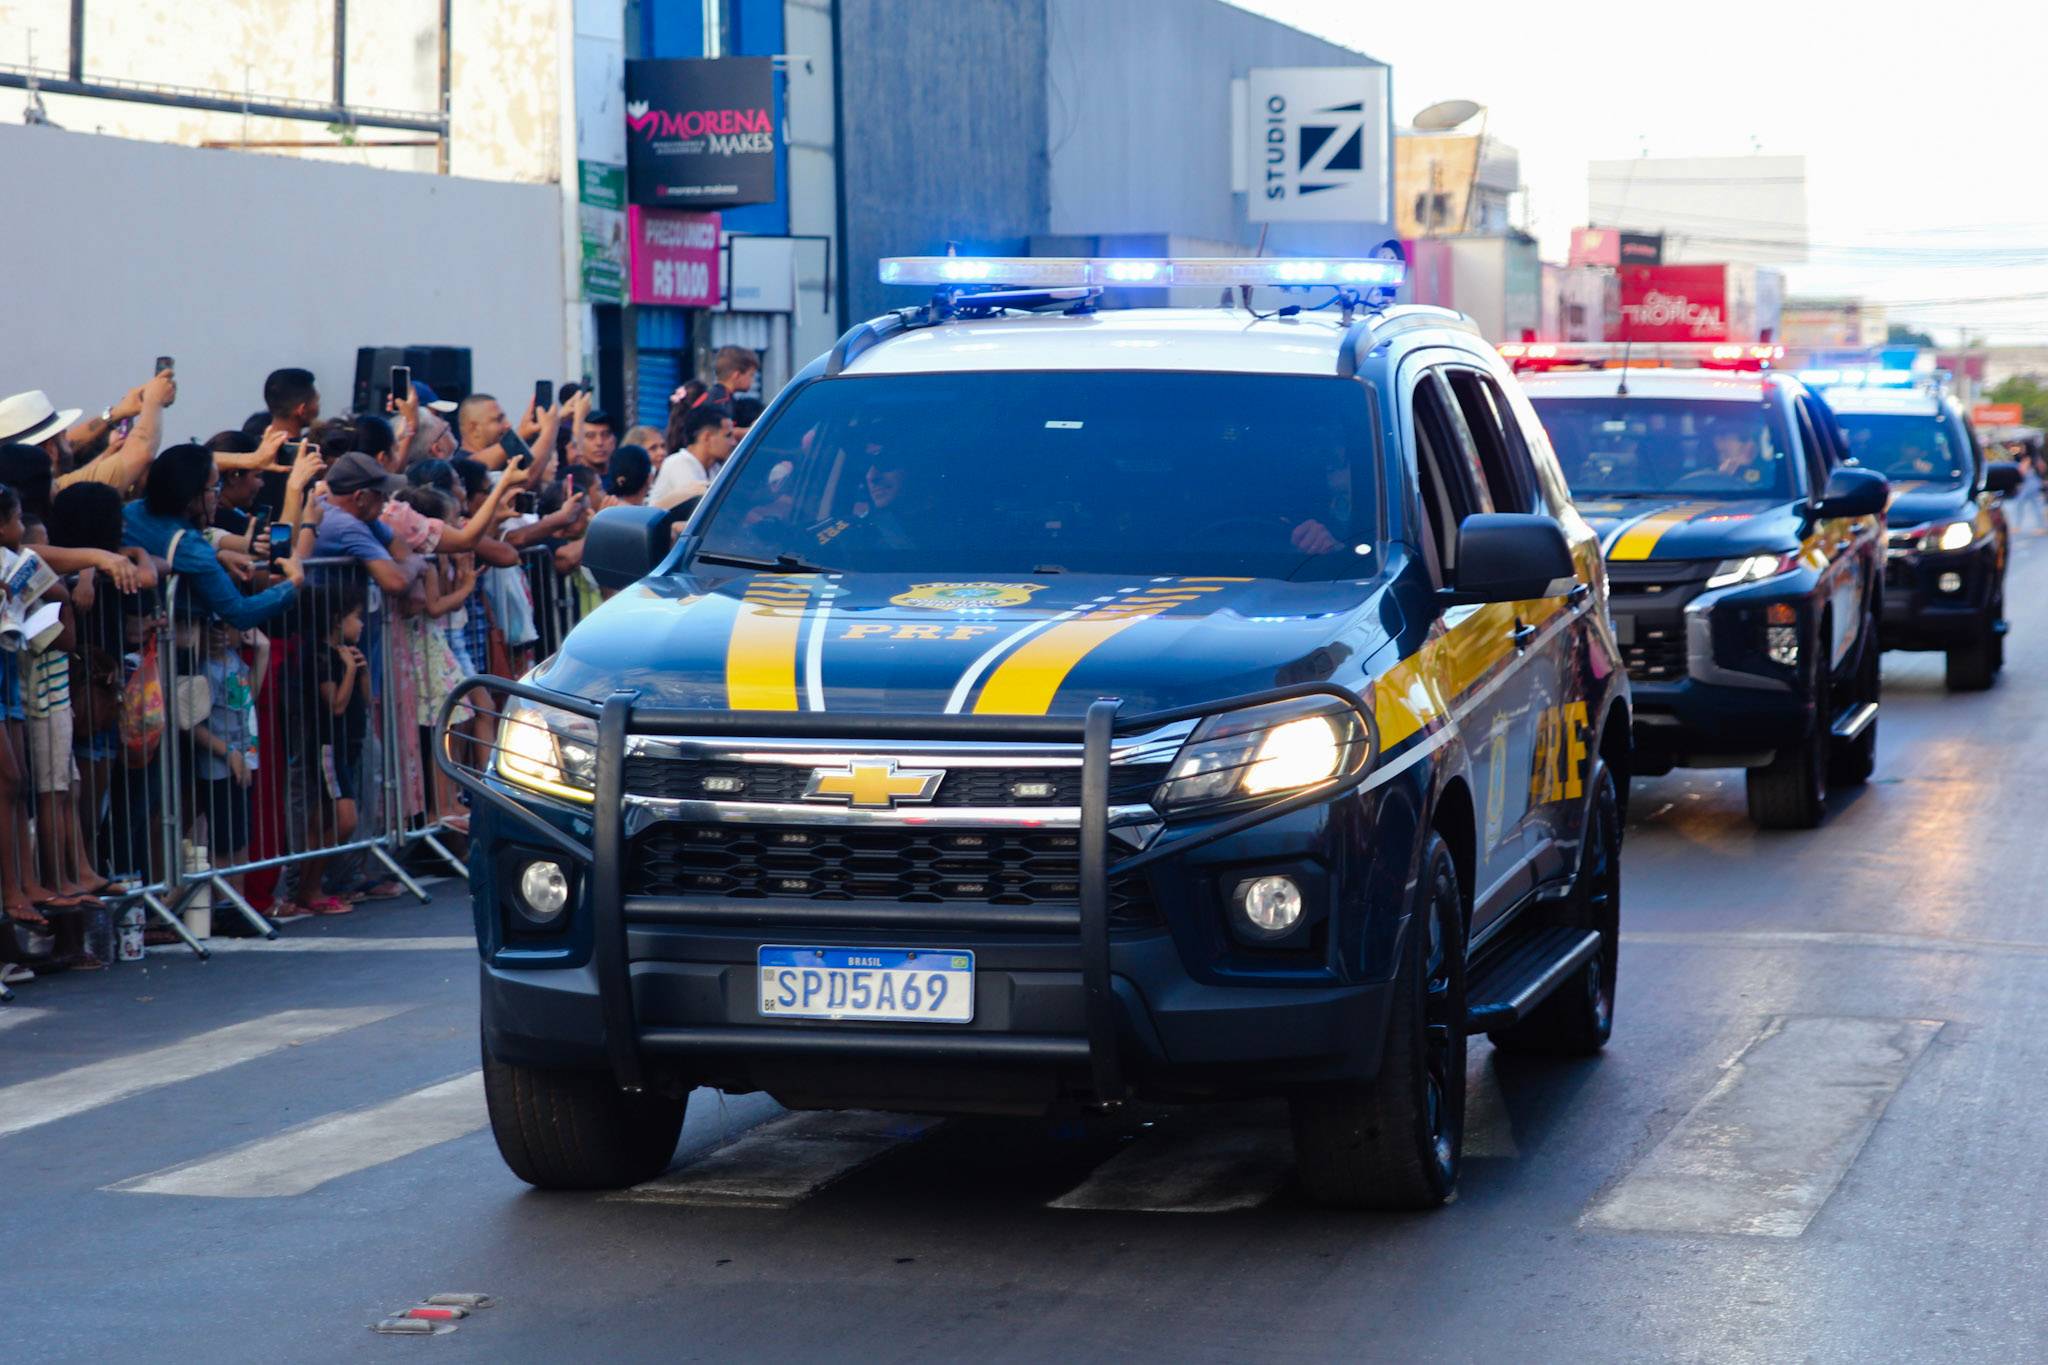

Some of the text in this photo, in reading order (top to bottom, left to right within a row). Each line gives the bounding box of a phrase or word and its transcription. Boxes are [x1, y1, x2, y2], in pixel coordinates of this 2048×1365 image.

[660, 108, 772, 139] MORENA
[709, 133, 773, 156] MAKES
[1267, 95, 1285, 199] STUDIO
[839, 624, 998, 641] PRF
[848, 956, 882, 968] BRASIL
[778, 969, 949, 1012] SPD5A69
[764, 999, 776, 1012] BR
